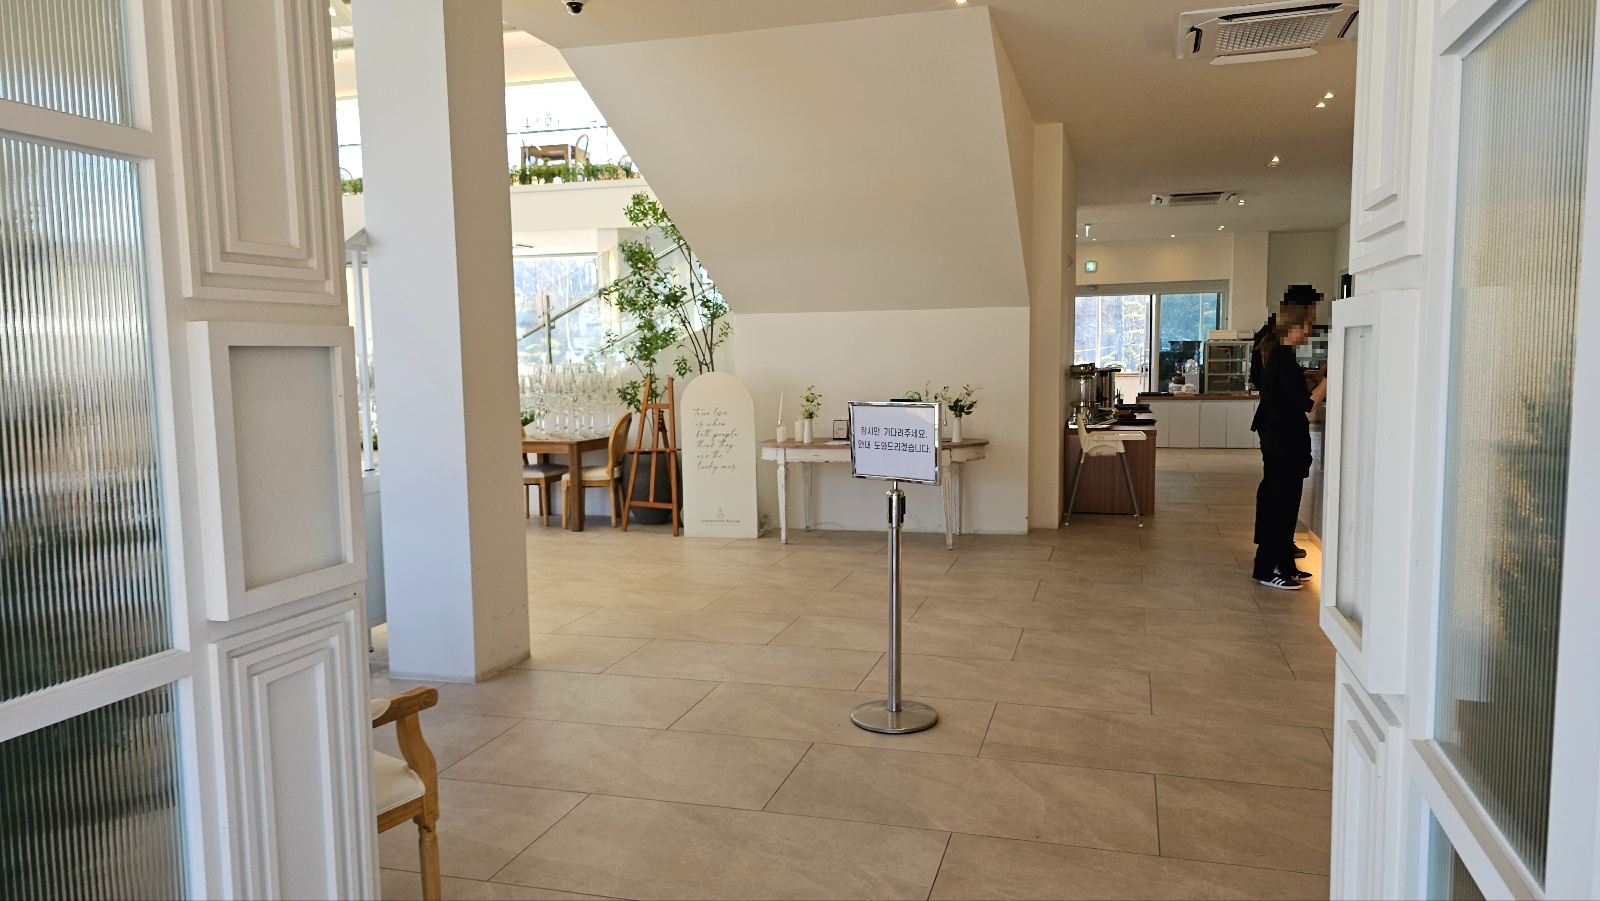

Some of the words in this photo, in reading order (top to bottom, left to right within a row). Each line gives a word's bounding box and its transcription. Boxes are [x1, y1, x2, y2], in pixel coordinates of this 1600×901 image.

[692, 407, 709, 418] True
[713, 407, 727, 417] love
[706, 418, 726, 427] when
[696, 428, 711, 438] both
[711, 428, 737, 442] people
[883, 427, 928, 439] 기다려주세요.
[696, 439, 715, 449] think
[718, 438, 734, 453] they
[858, 439, 871, 449] 안내
[874, 441, 932, 453] 도와드리겠습니다.
[711, 449, 722, 459] the
[697, 460, 718, 475] lucky
[721, 463, 736, 471] ones
